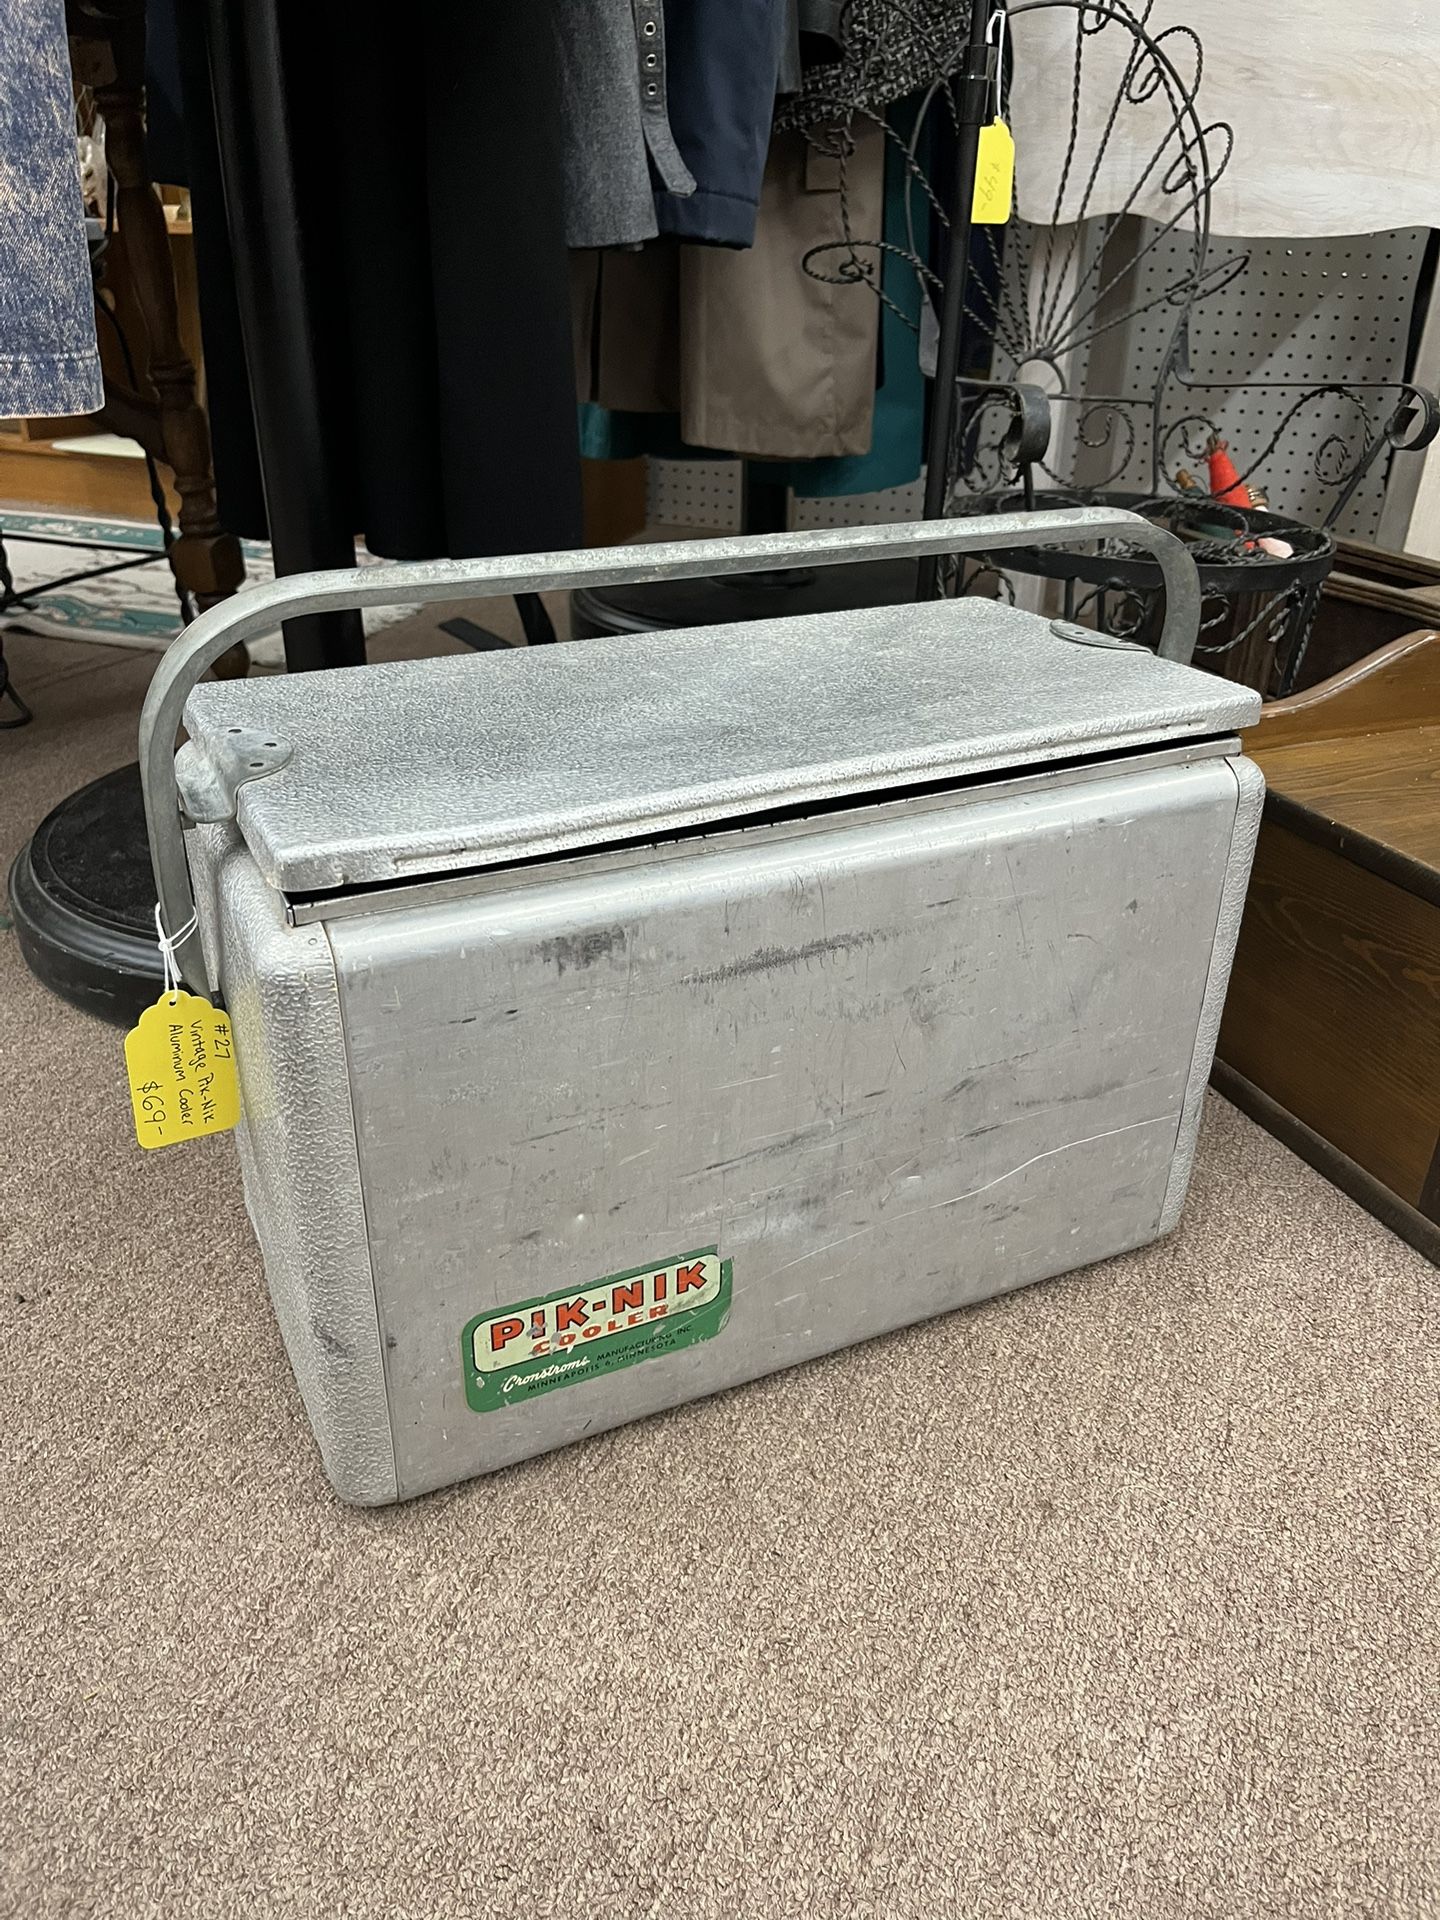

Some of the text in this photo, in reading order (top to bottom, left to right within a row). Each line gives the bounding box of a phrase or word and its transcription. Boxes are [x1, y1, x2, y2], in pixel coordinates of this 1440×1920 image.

[188, 1019, 207, 1072] Vintage
[168, 1024, 194, 1124] Aluminum Cooler
[491, 1261, 708, 1352] PIK-NIK
[531, 1303, 669, 1355] COOLER
[527, 1363, 600, 1392] MINNEAPOLIS
[617, 1338, 677, 1364] MINNESOTA
